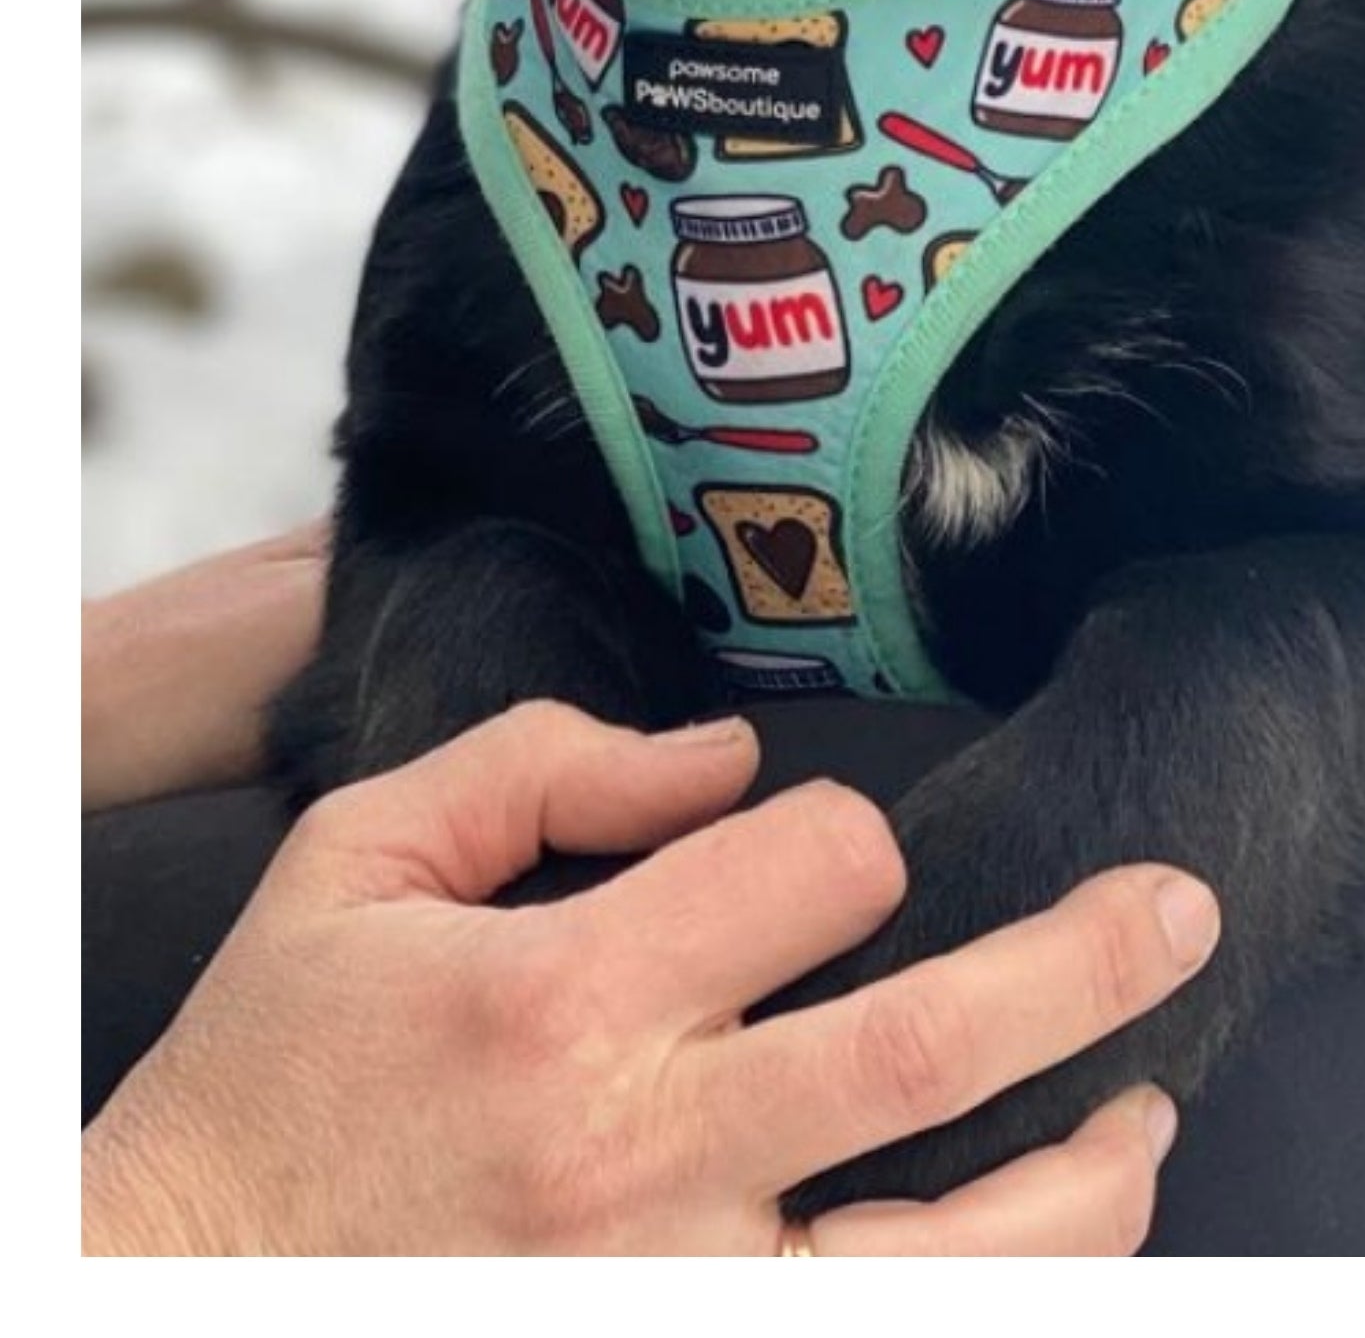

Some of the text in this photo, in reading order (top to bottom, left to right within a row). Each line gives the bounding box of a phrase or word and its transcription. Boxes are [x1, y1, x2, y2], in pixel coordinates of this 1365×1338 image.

[668, 59, 781, 86] pawsome
[984, 40, 1105, 98] yum
[686, 292, 833, 368] yum
